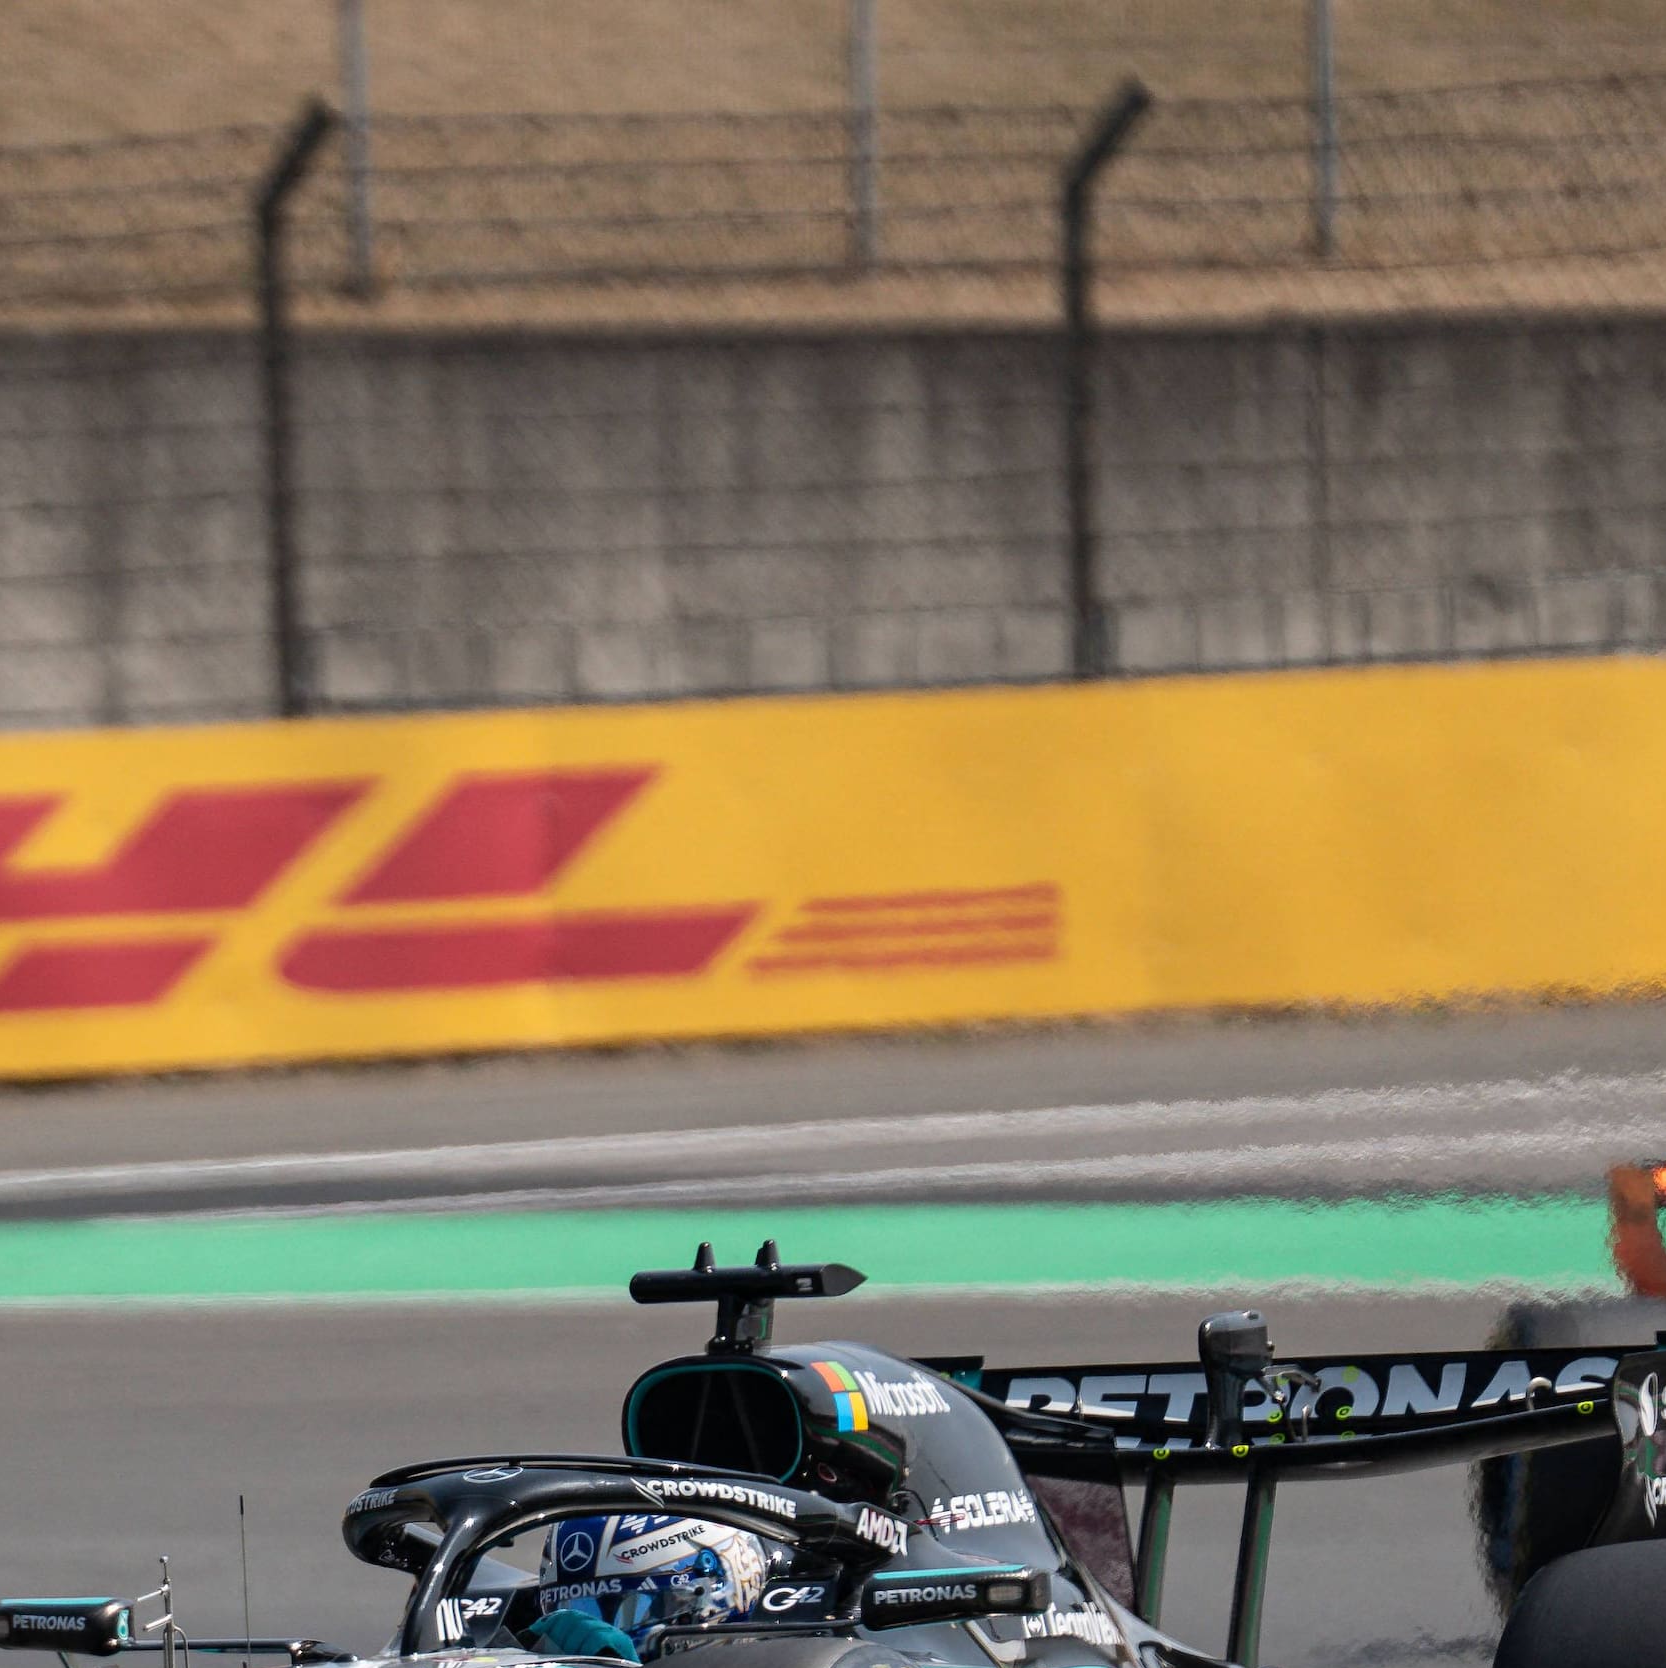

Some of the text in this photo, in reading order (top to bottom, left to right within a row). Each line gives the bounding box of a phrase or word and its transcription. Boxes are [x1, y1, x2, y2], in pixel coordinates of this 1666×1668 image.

[853, 1370, 951, 1416] Microsoft
[645, 1479, 797, 1519] CROWDSTRIKE
[950, 1492, 1026, 1531] SOLERA
[621, 1524, 706, 1560] CROWDSTRIKE
[856, 1507, 893, 1546] AMD
[540, 1578, 623, 1603] PETRONAS
[762, 1586, 825, 1612] G42
[873, 1584, 977, 1605] PETRONAS
[12, 1614, 86, 1631] PETRONAS
